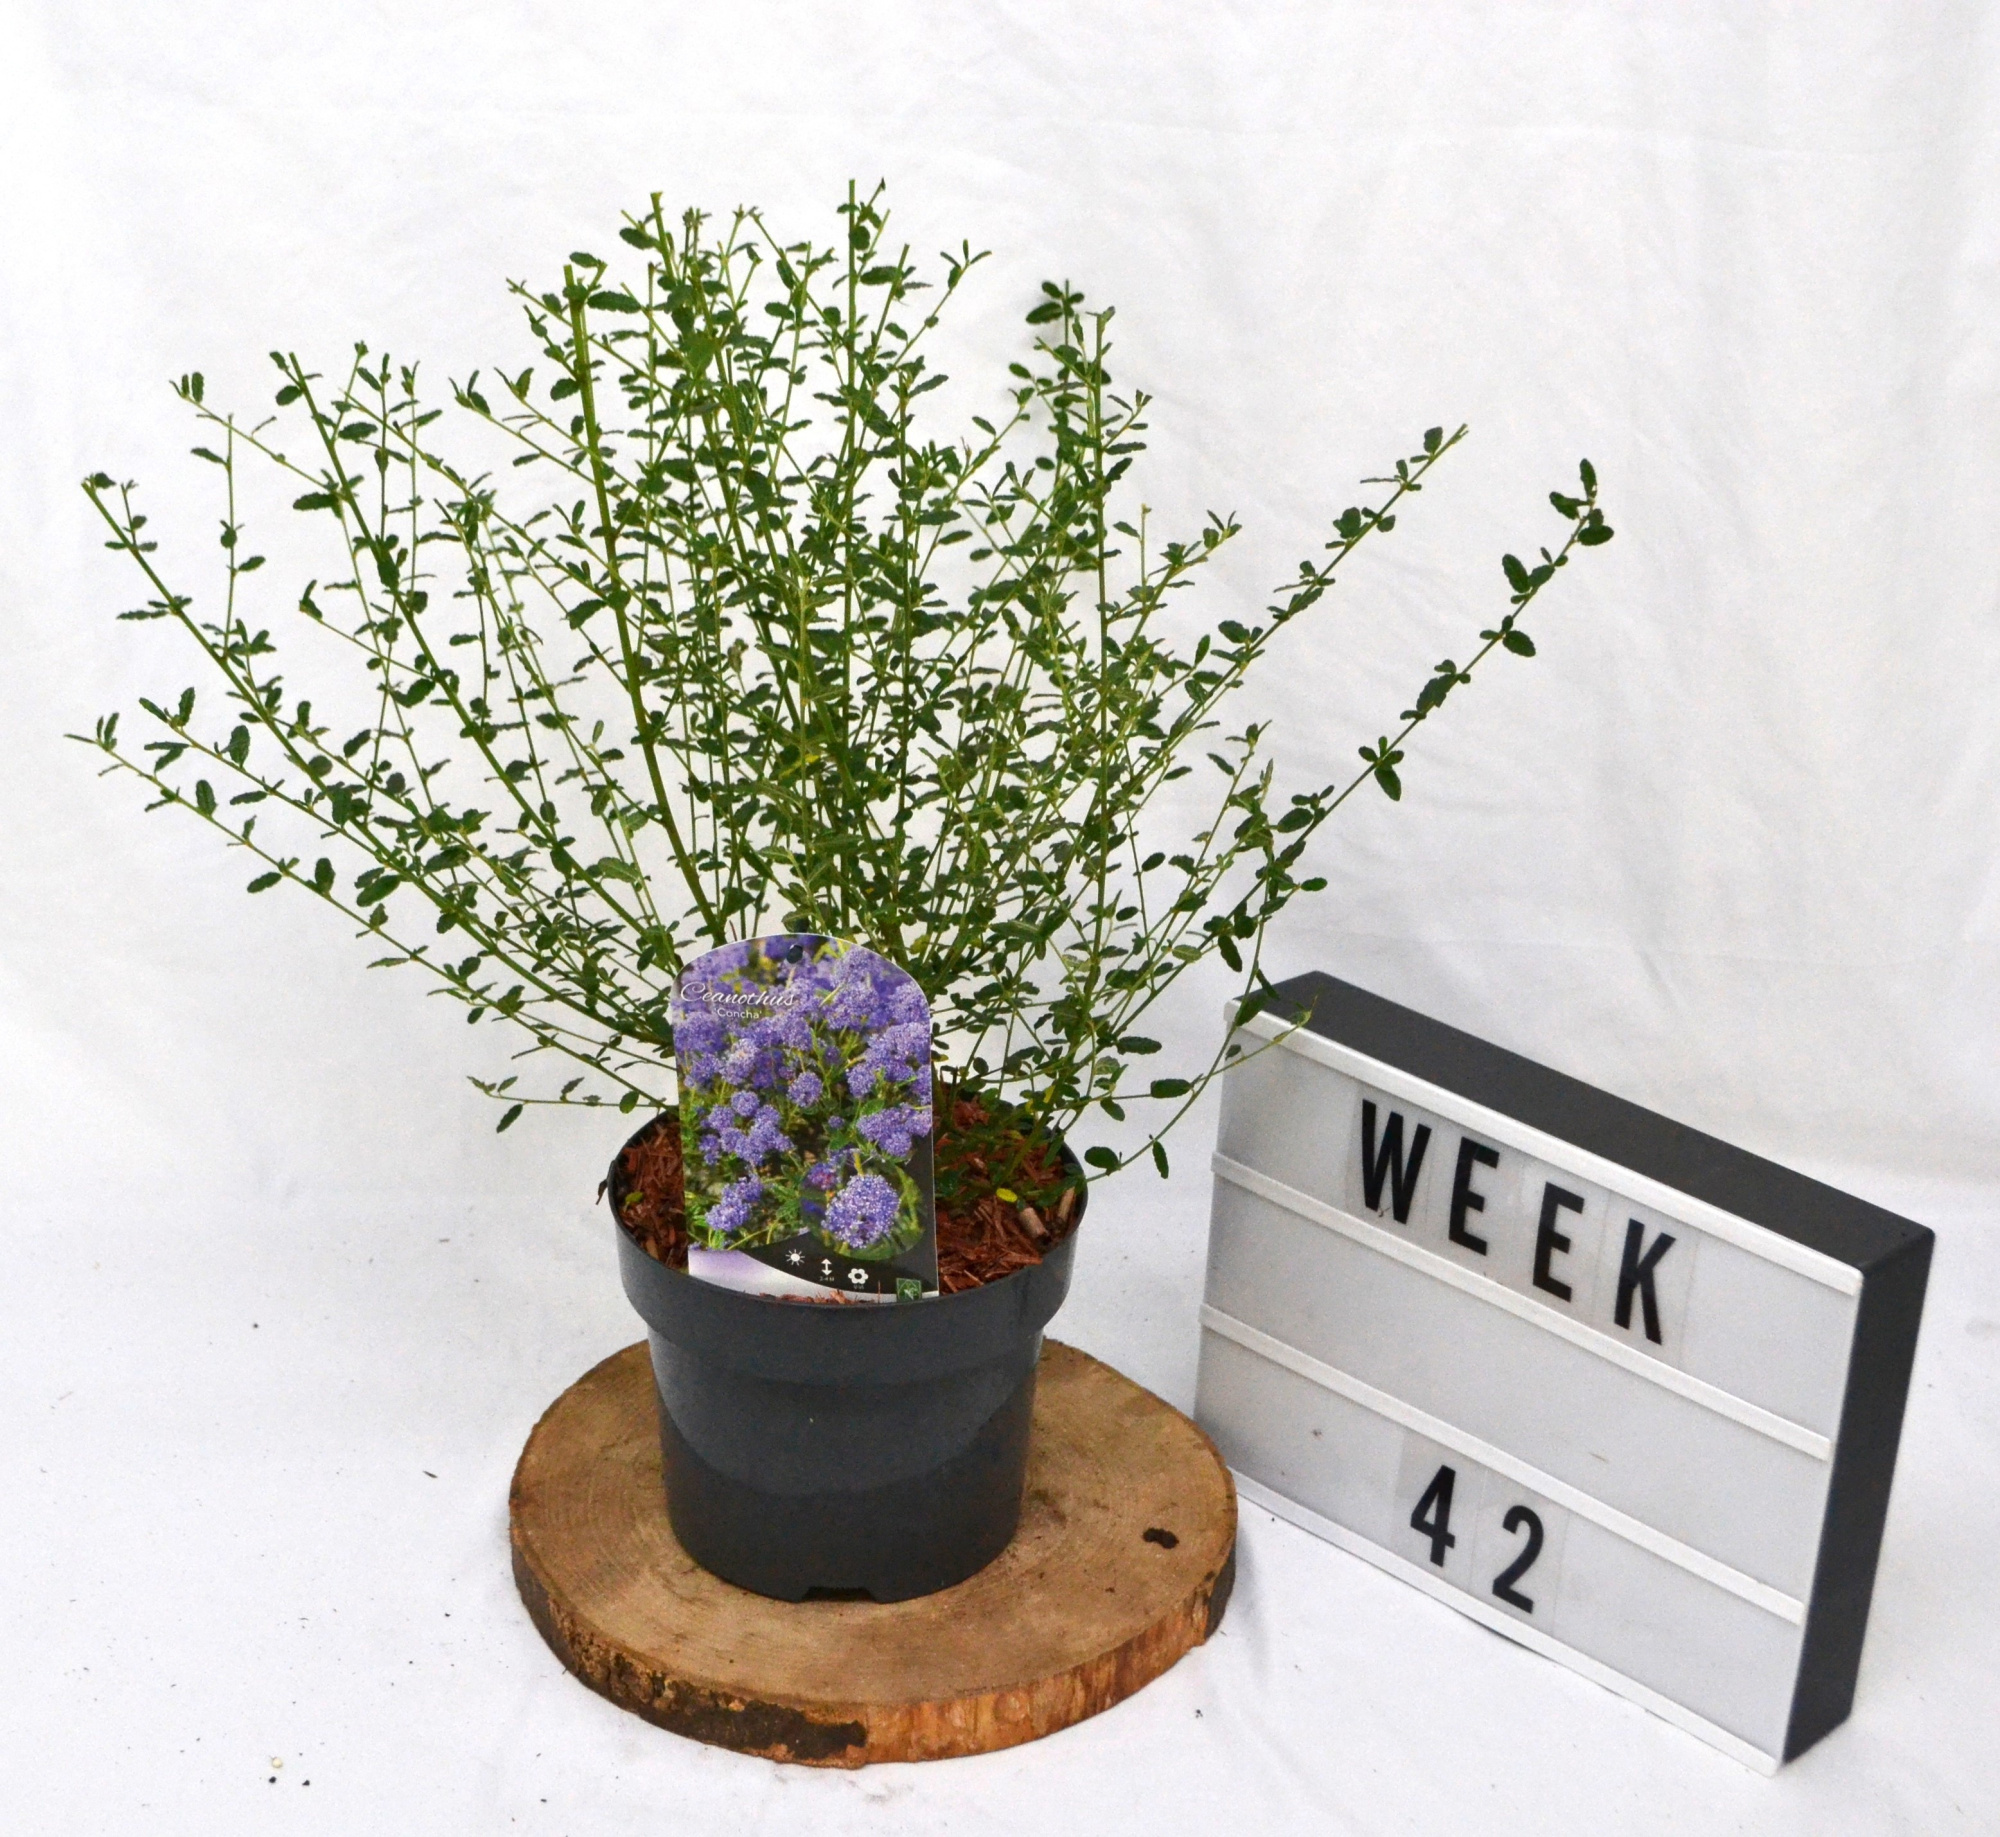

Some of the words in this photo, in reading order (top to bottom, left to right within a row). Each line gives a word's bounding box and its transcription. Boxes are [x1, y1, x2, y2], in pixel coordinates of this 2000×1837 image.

[680, 981, 795, 1007] Ceanothus
[714, 1007, 762, 1019] 'Concha'
[1361, 1099, 1676, 1345] WEEK
[1411, 1465, 1543, 1613] 42
